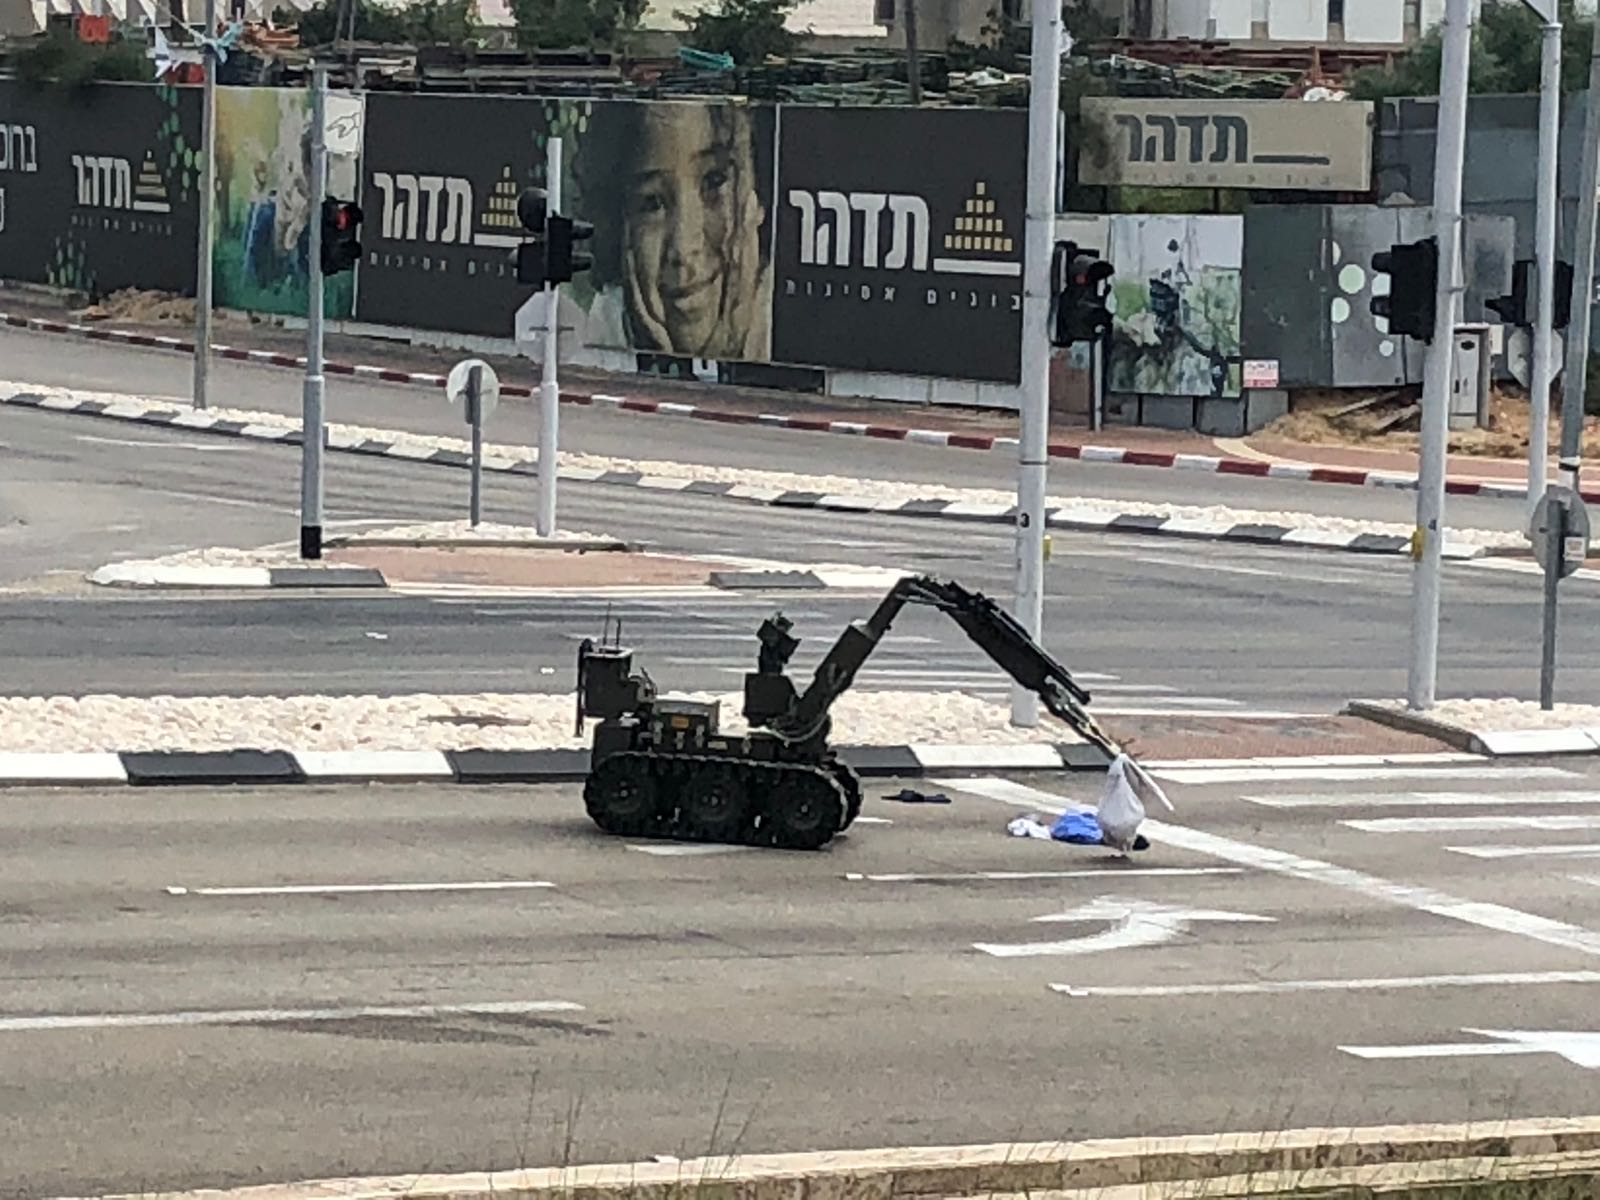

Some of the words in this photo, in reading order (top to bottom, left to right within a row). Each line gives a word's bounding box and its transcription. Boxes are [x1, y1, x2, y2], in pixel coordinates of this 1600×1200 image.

[1113, 114, 1248, 164] תדהר
[72, 155, 131, 209] תדהר
[373, 172, 473, 244] תדהר
[789, 190, 930, 271] תדהר
